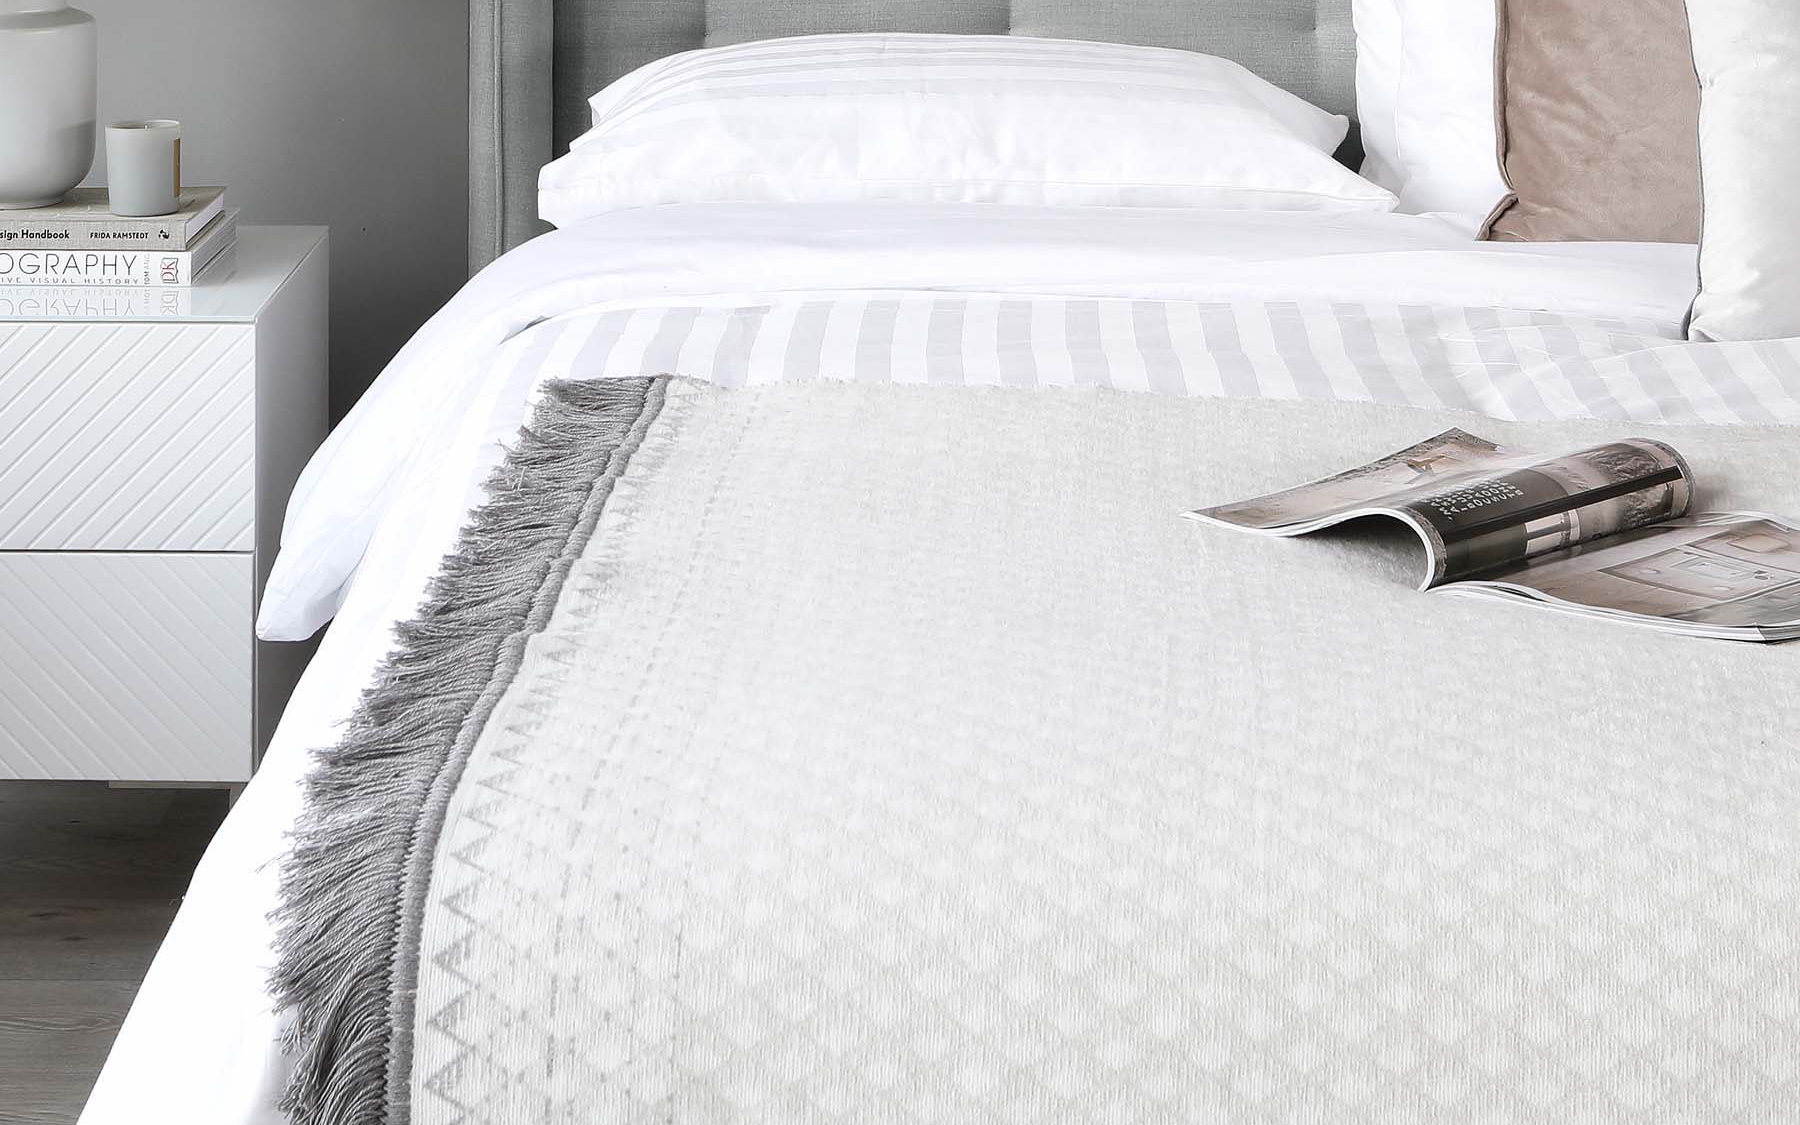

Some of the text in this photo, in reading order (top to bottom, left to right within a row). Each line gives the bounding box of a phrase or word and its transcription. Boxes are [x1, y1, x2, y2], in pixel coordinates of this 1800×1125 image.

[21, 229, 70, 239] Handbook
[0, 253, 137, 276] OGRAPHY
[162, 259, 176, 282] DK
